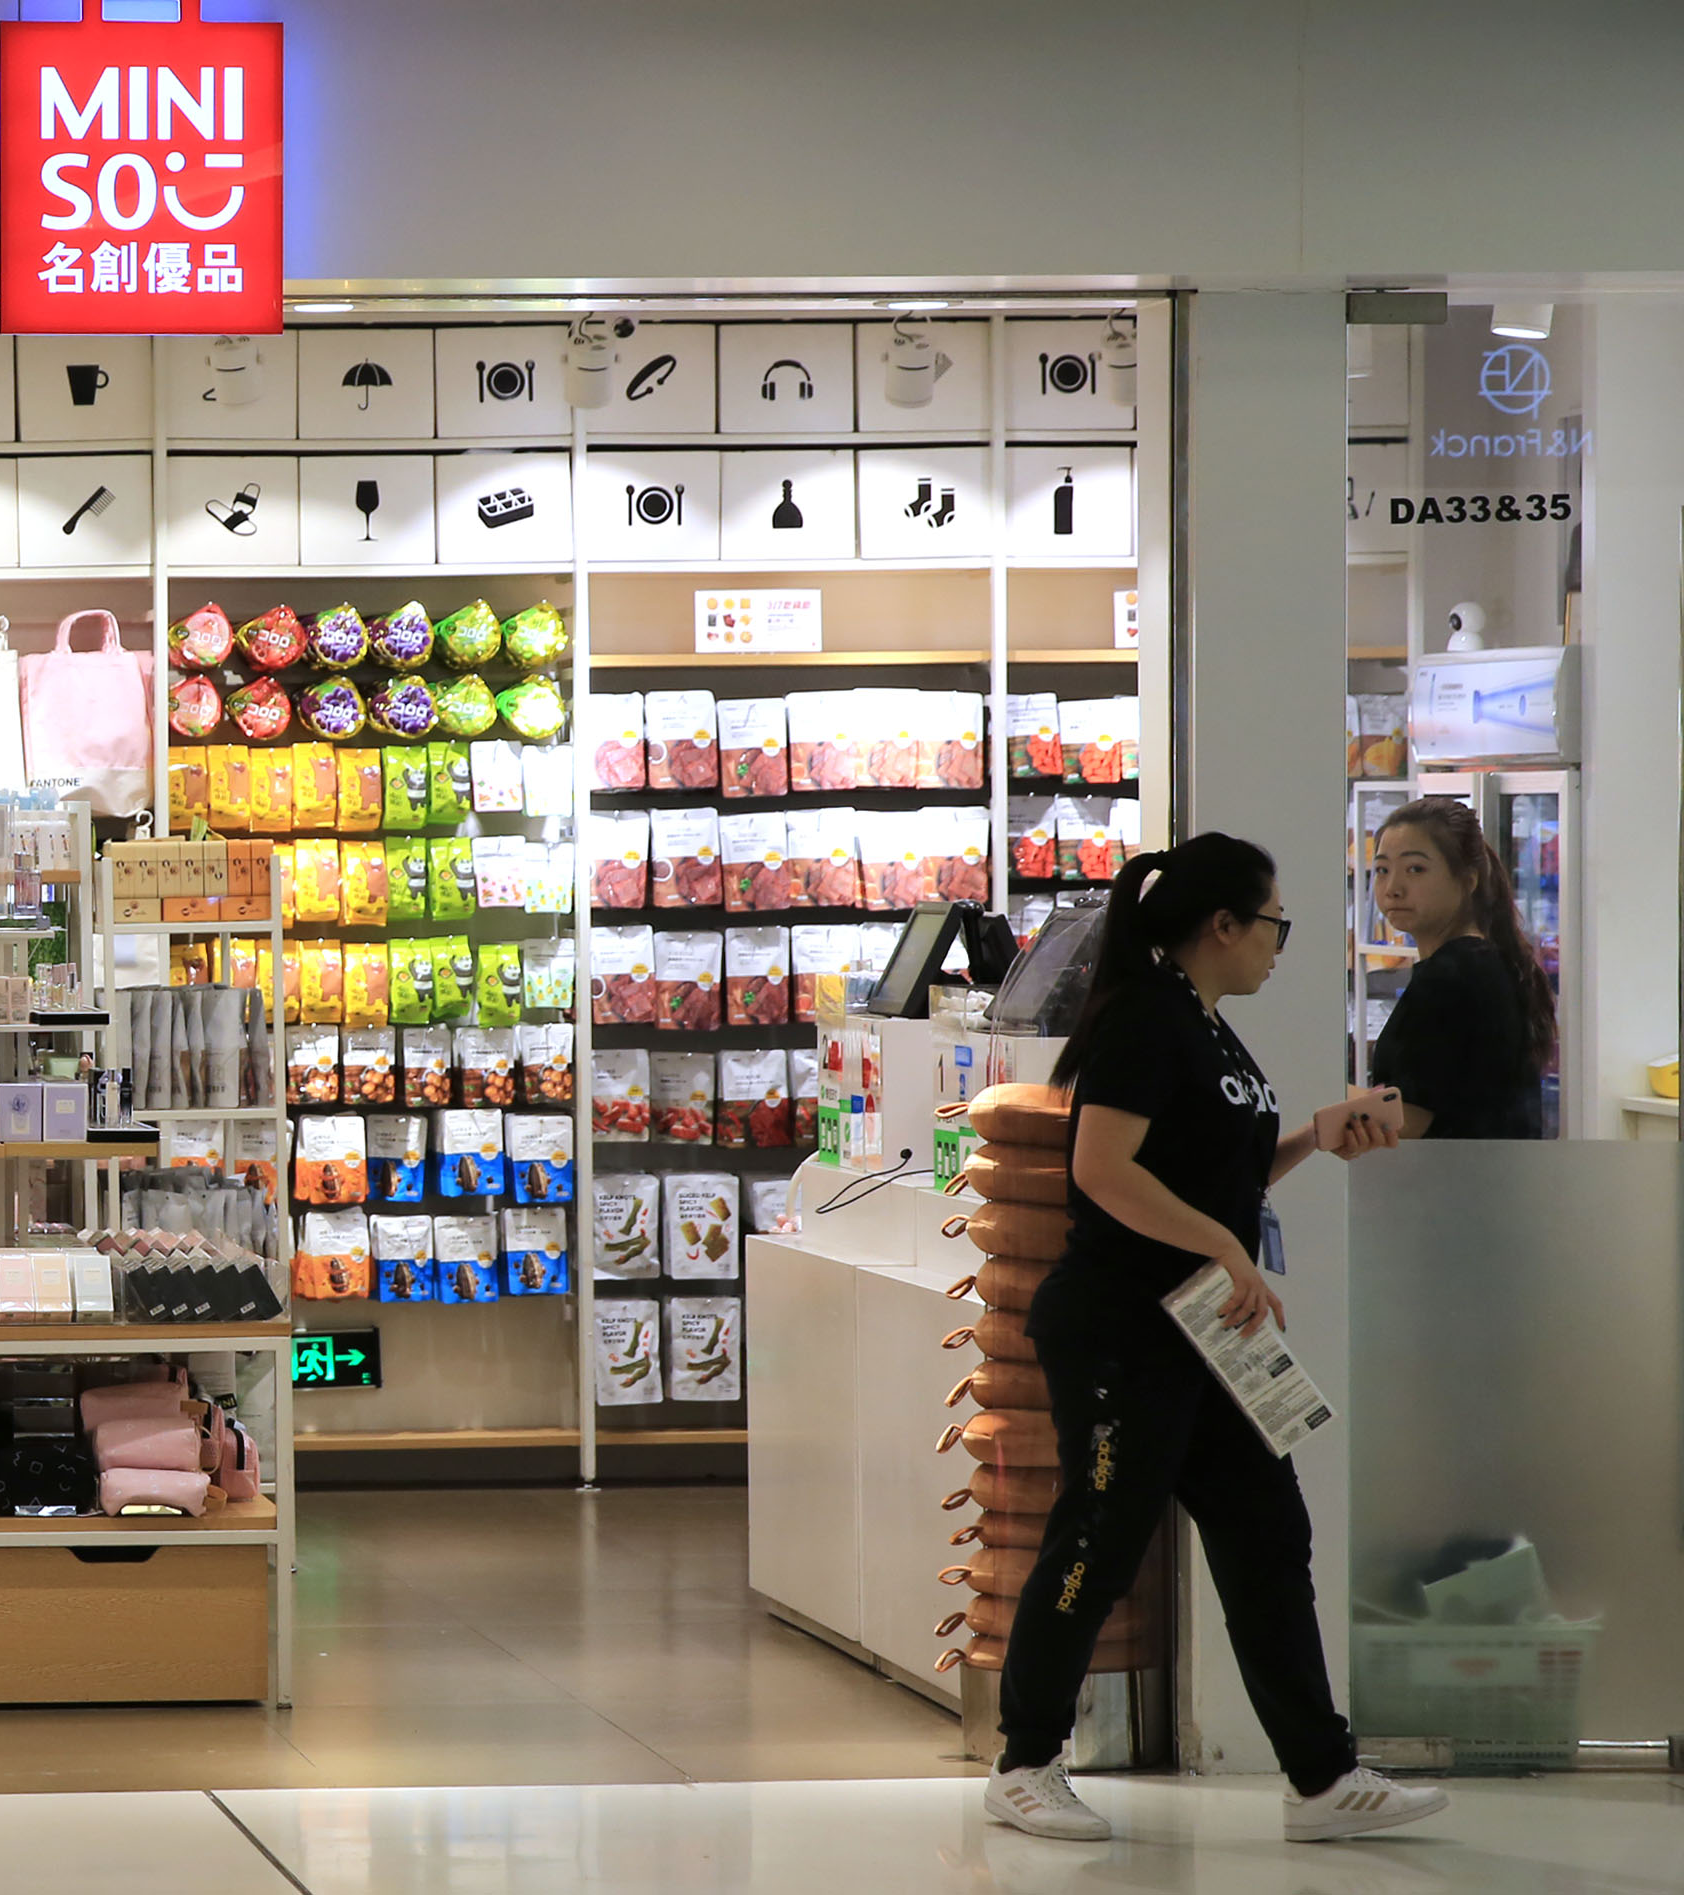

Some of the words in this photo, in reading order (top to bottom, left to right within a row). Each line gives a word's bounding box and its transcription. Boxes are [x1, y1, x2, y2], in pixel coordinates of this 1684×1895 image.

[40, 66, 244, 140] MINI
[37, 240, 244, 294] 名創優品
[1390, 493, 1572, 524] DA33&35
